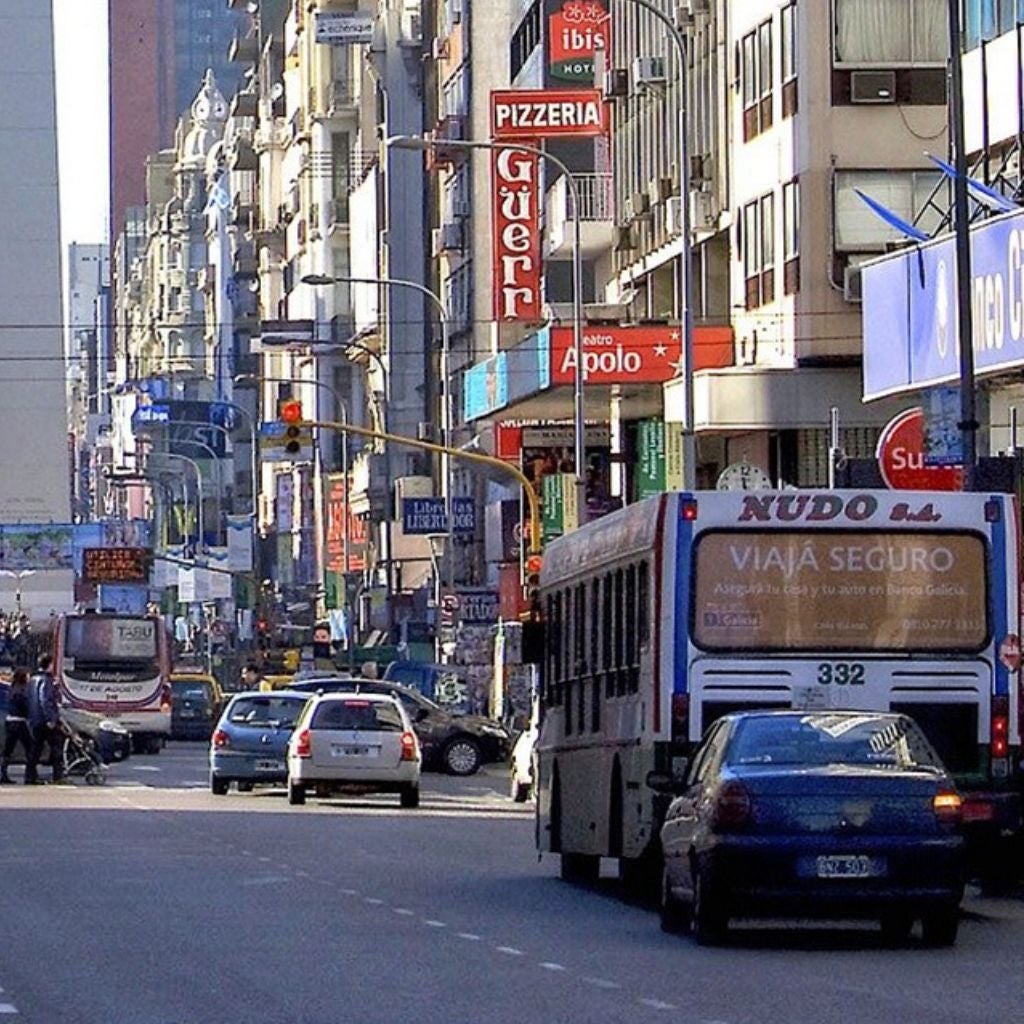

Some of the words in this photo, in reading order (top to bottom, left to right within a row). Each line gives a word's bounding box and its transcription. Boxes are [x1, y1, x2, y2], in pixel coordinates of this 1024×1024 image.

[562, 28, 605, 50] ibis
[564, 64, 596, 74] HOT
[495, 102, 601, 127] PIZZERIA
[582, 333, 614, 346] eatro
[561, 343, 642, 380] Apolo
[413, 501, 474, 514] Libreas
[738, 494, 878, 522] NUDO
[407, 515, 474, 529] LIBERTDOR
[829, 546, 955, 572] SEGURO
[869, 585, 884, 595] en
[817, 663, 866, 685] 332
